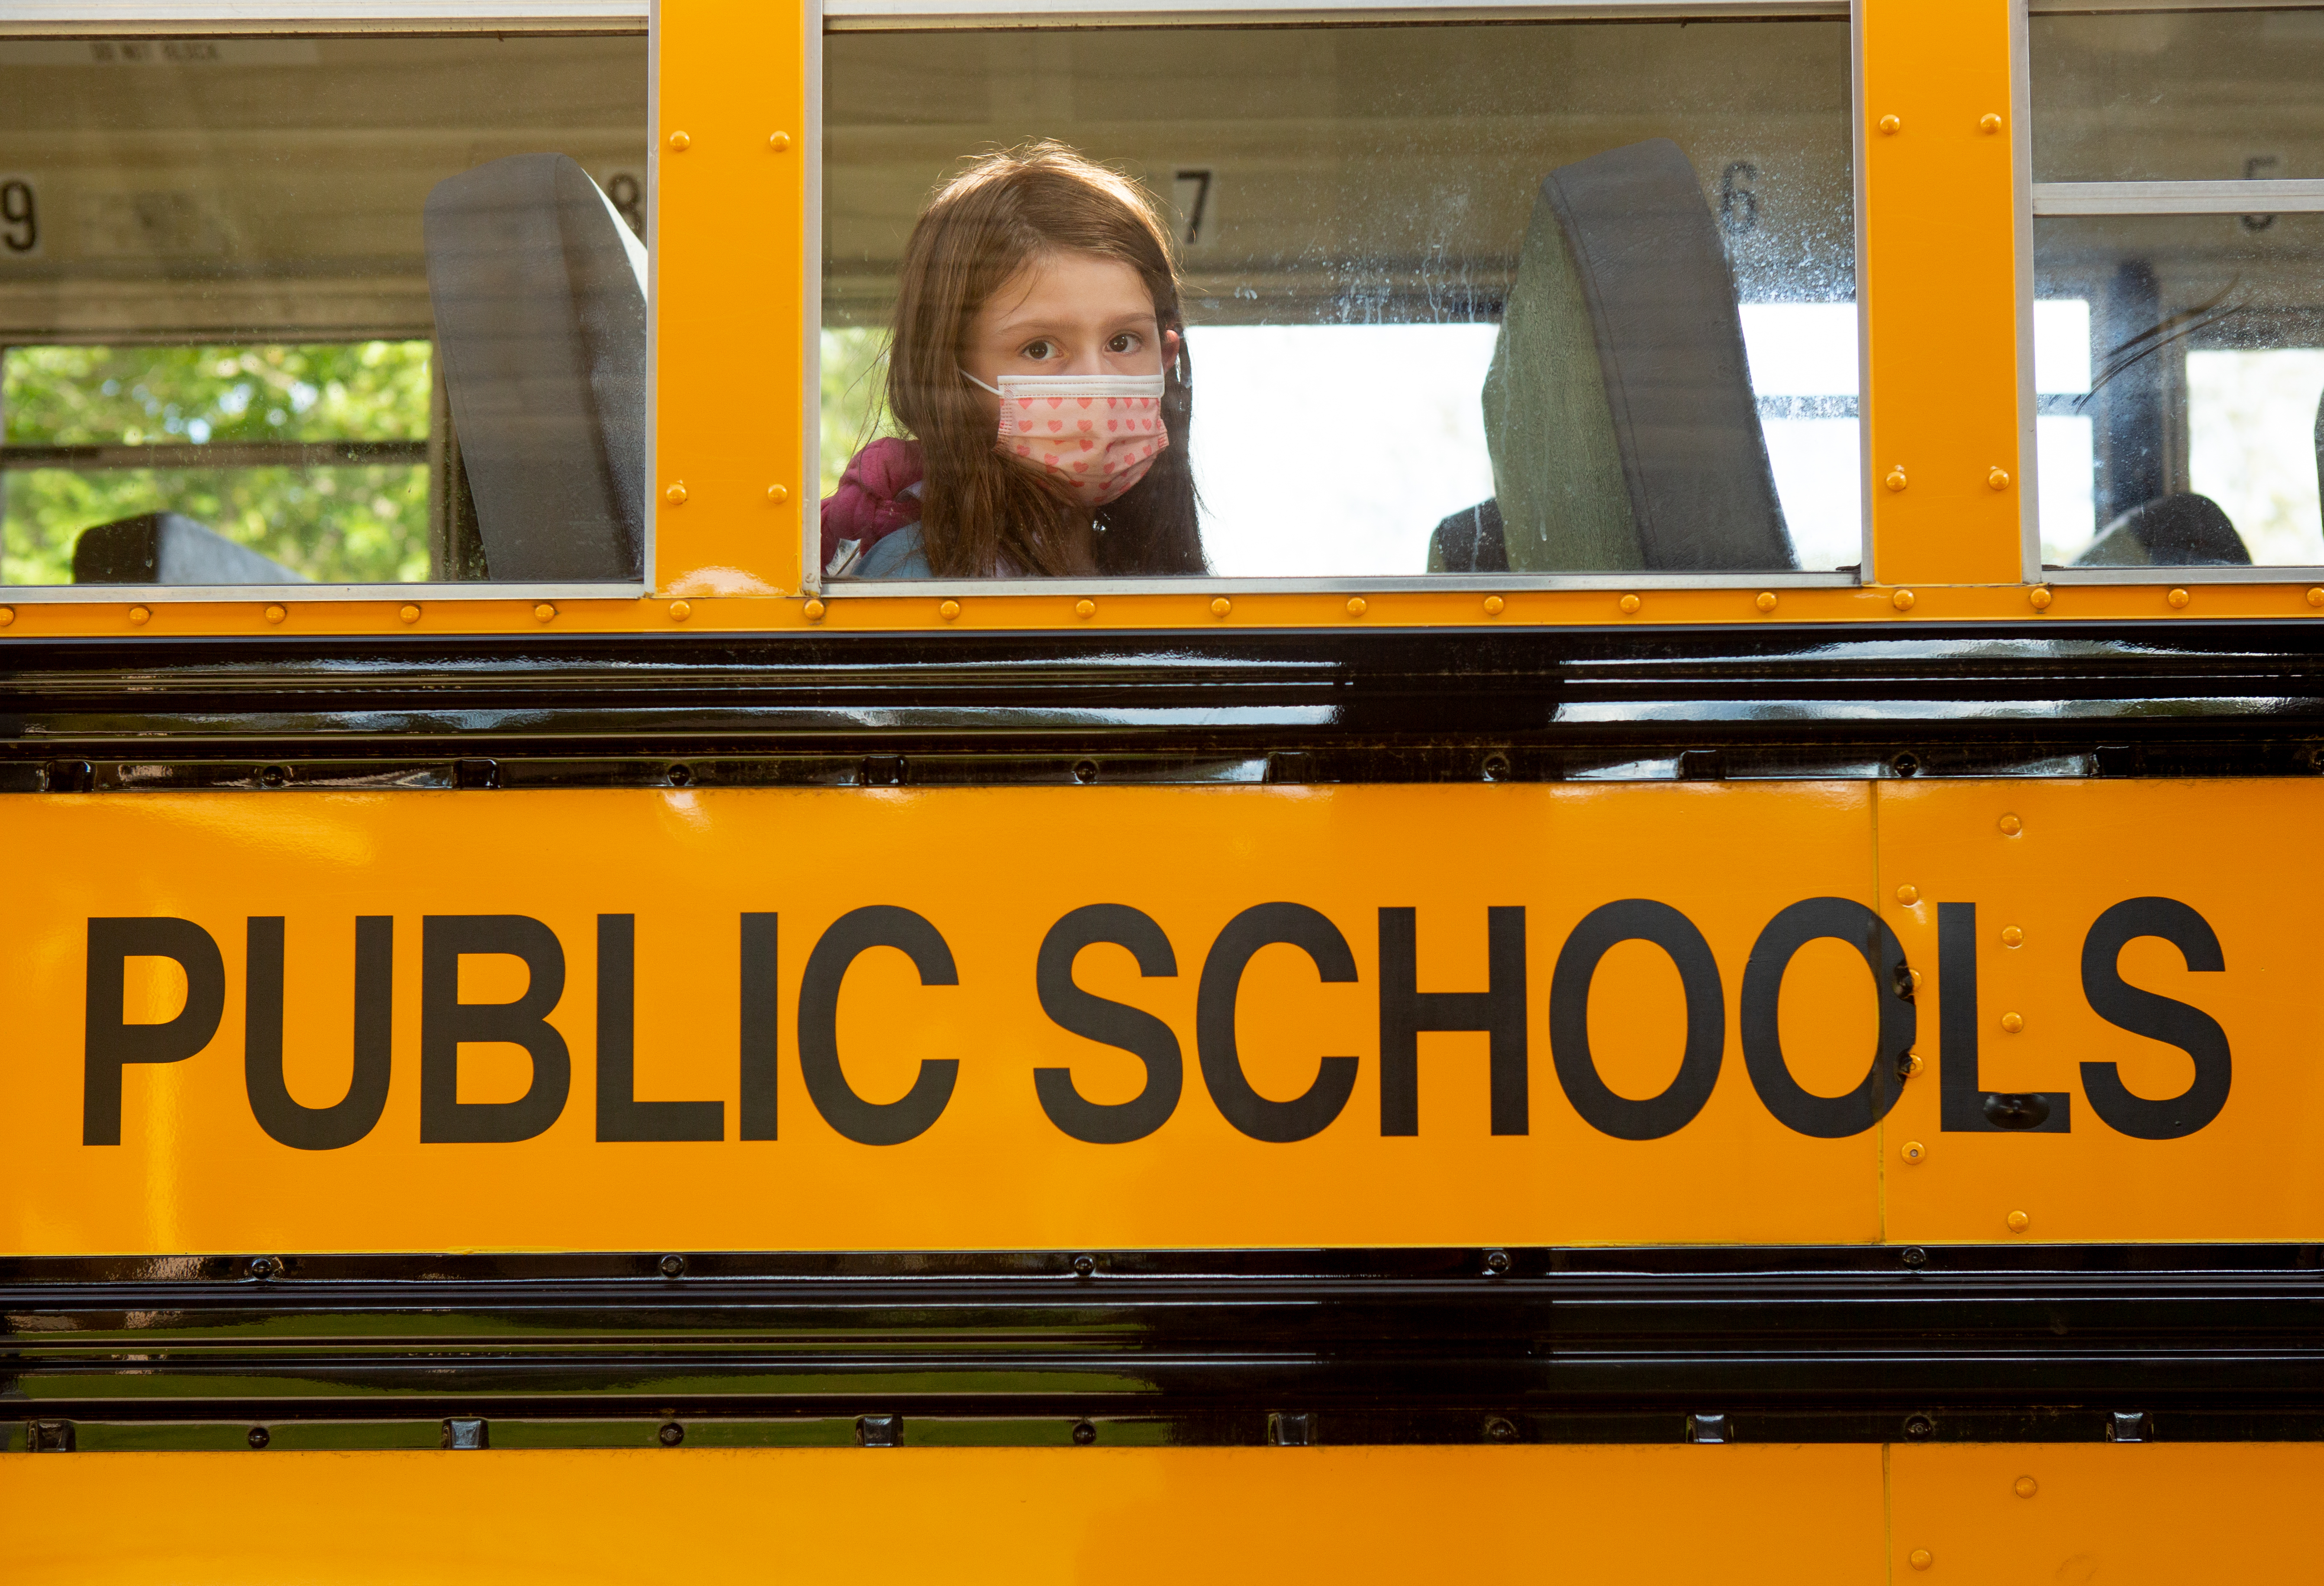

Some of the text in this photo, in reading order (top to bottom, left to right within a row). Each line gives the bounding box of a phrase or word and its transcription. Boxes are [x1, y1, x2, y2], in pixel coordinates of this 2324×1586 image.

[0, 181, 35, 251] 9
[1176, 169, 1211, 244] 7
[1721, 161, 1757, 235] 6
[83, 897, 2231, 1150] PUBLIC SCHOOLS
